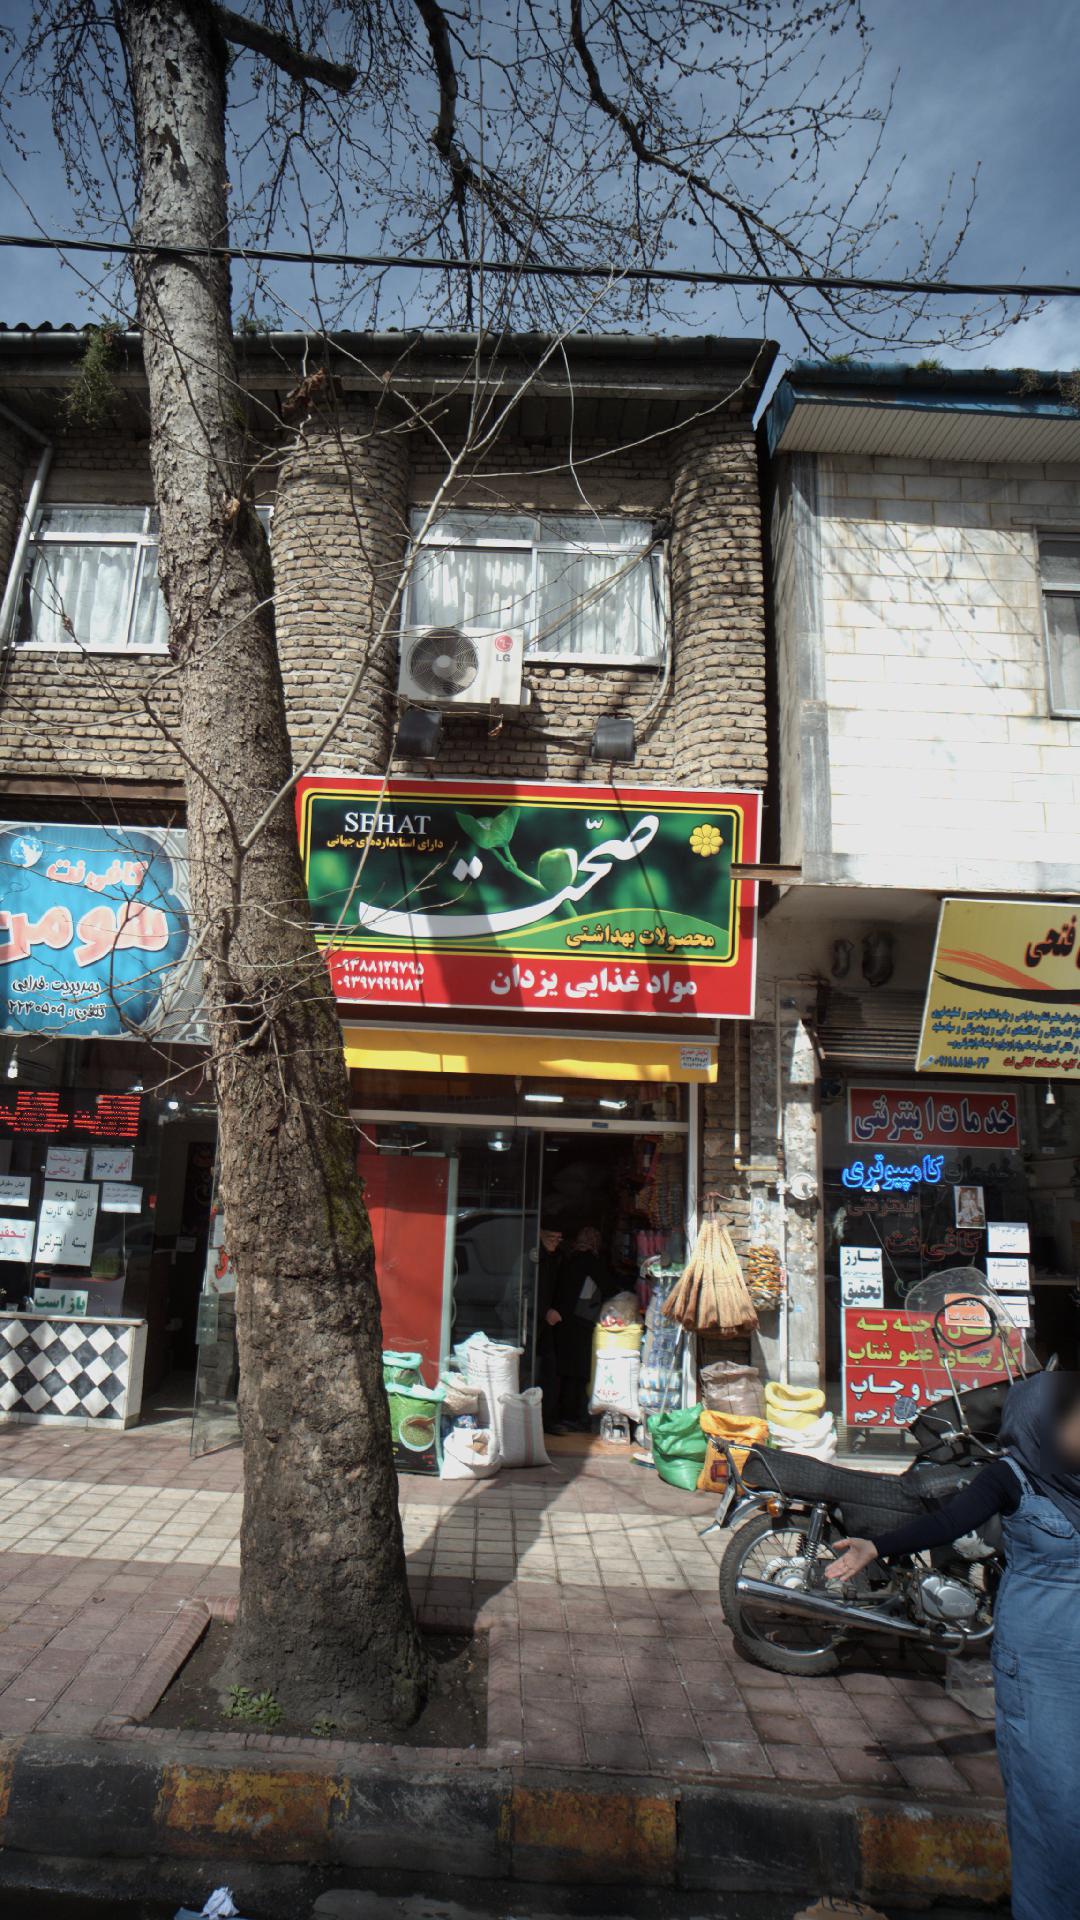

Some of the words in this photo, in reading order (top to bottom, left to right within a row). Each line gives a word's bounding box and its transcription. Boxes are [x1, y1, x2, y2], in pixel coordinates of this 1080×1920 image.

[496, 654, 510, 663] LG
[344, 812, 431, 834] SEHAT
[327, 834, 356, 848] جهانی
[417, 840, 444, 852] دارای
[46, 859, 86, 884] نت
[84, 859, 149, 892] کافی
[566, 924, 635, 948] بهداشتی
[638, 926, 715, 951] محصولات
[490, 964, 558, 998] یزدان
[565, 967, 640, 998] غذایی
[646, 970, 698, 1003] مواد
[855, 1095, 935, 1141] اینترنتی
[937, 1097, 1016, 1134] خدمات
[844, 1249, 881, 1265] شارژ
[35, 1294, 66, 1309] است
[843, 1280, 882, 1305] تحقیق
[66, 1295, 86, 1314] باز
[856, 1317, 888, 1335] به
[848, 1341, 892, 1364] شتاب
[897, 1345, 934, 1367] عضو
[850, 1374, 905, 1401] چاپ
[854, 1407, 891, 1424] ترحیم
